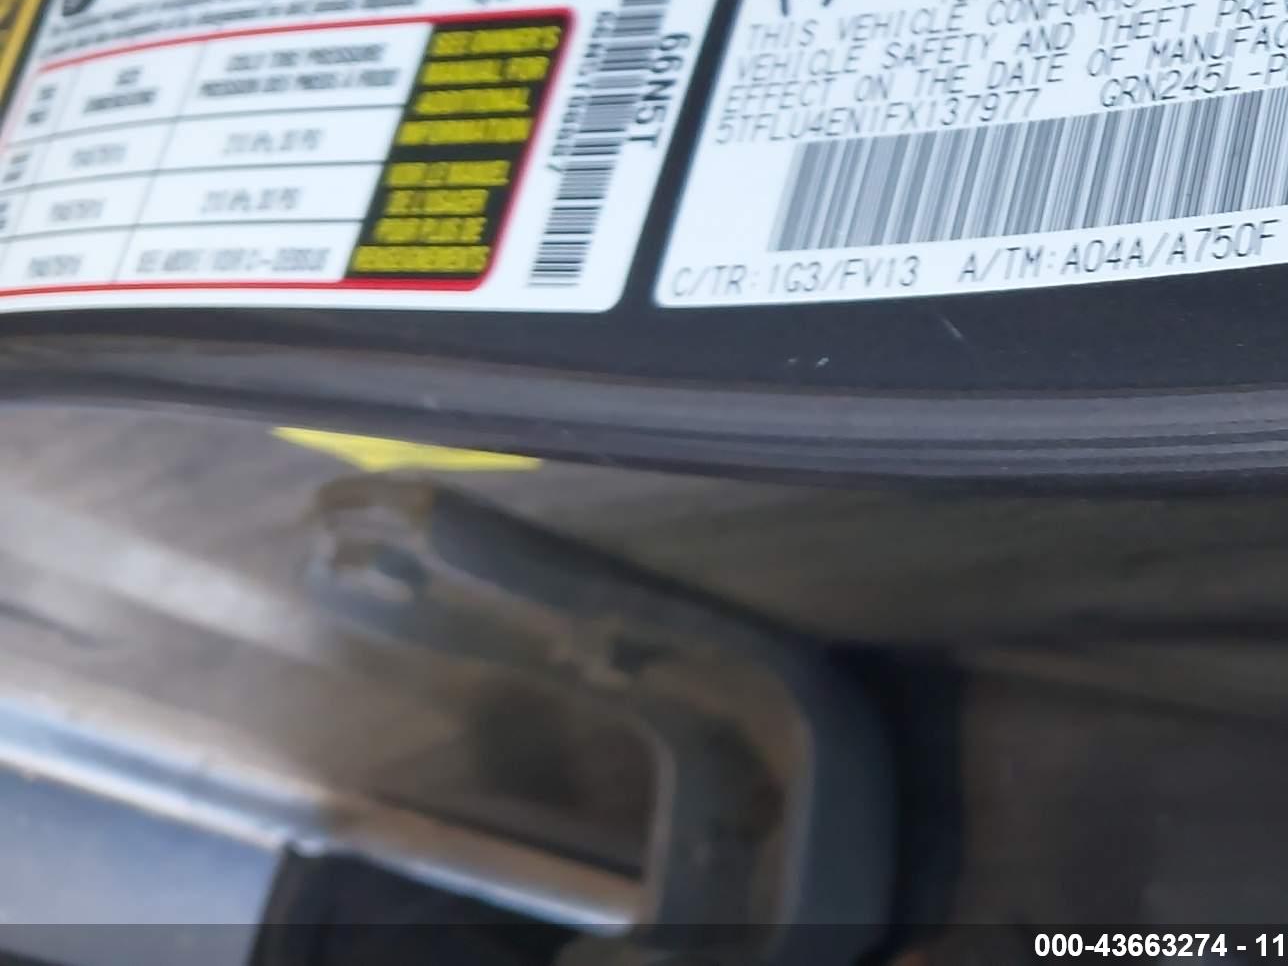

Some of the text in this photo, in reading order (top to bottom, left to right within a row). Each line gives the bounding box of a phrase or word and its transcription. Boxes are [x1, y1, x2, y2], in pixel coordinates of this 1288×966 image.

[738, 44, 864, 82] VEHICLE
[881, 33, 997, 70] SAFETY
[1016, 21, 1076, 55] AND
[1099, 3, 1197, 46] THEFT
[749, 19, 818, 50] THIS
[838, 3, 967, 42] VEHICLE
[626, 32, 690, 149] 66N5T
[723, 77, 837, 113] EFFECT
[853, 74, 897, 103] ON
[913, 63, 972, 97] THE
[986, 52, 1070, 90] DATE
[1086, 44, 1130, 78] OF
[715, 87, 1041, 145] 5TFLU4EN1FX137977
